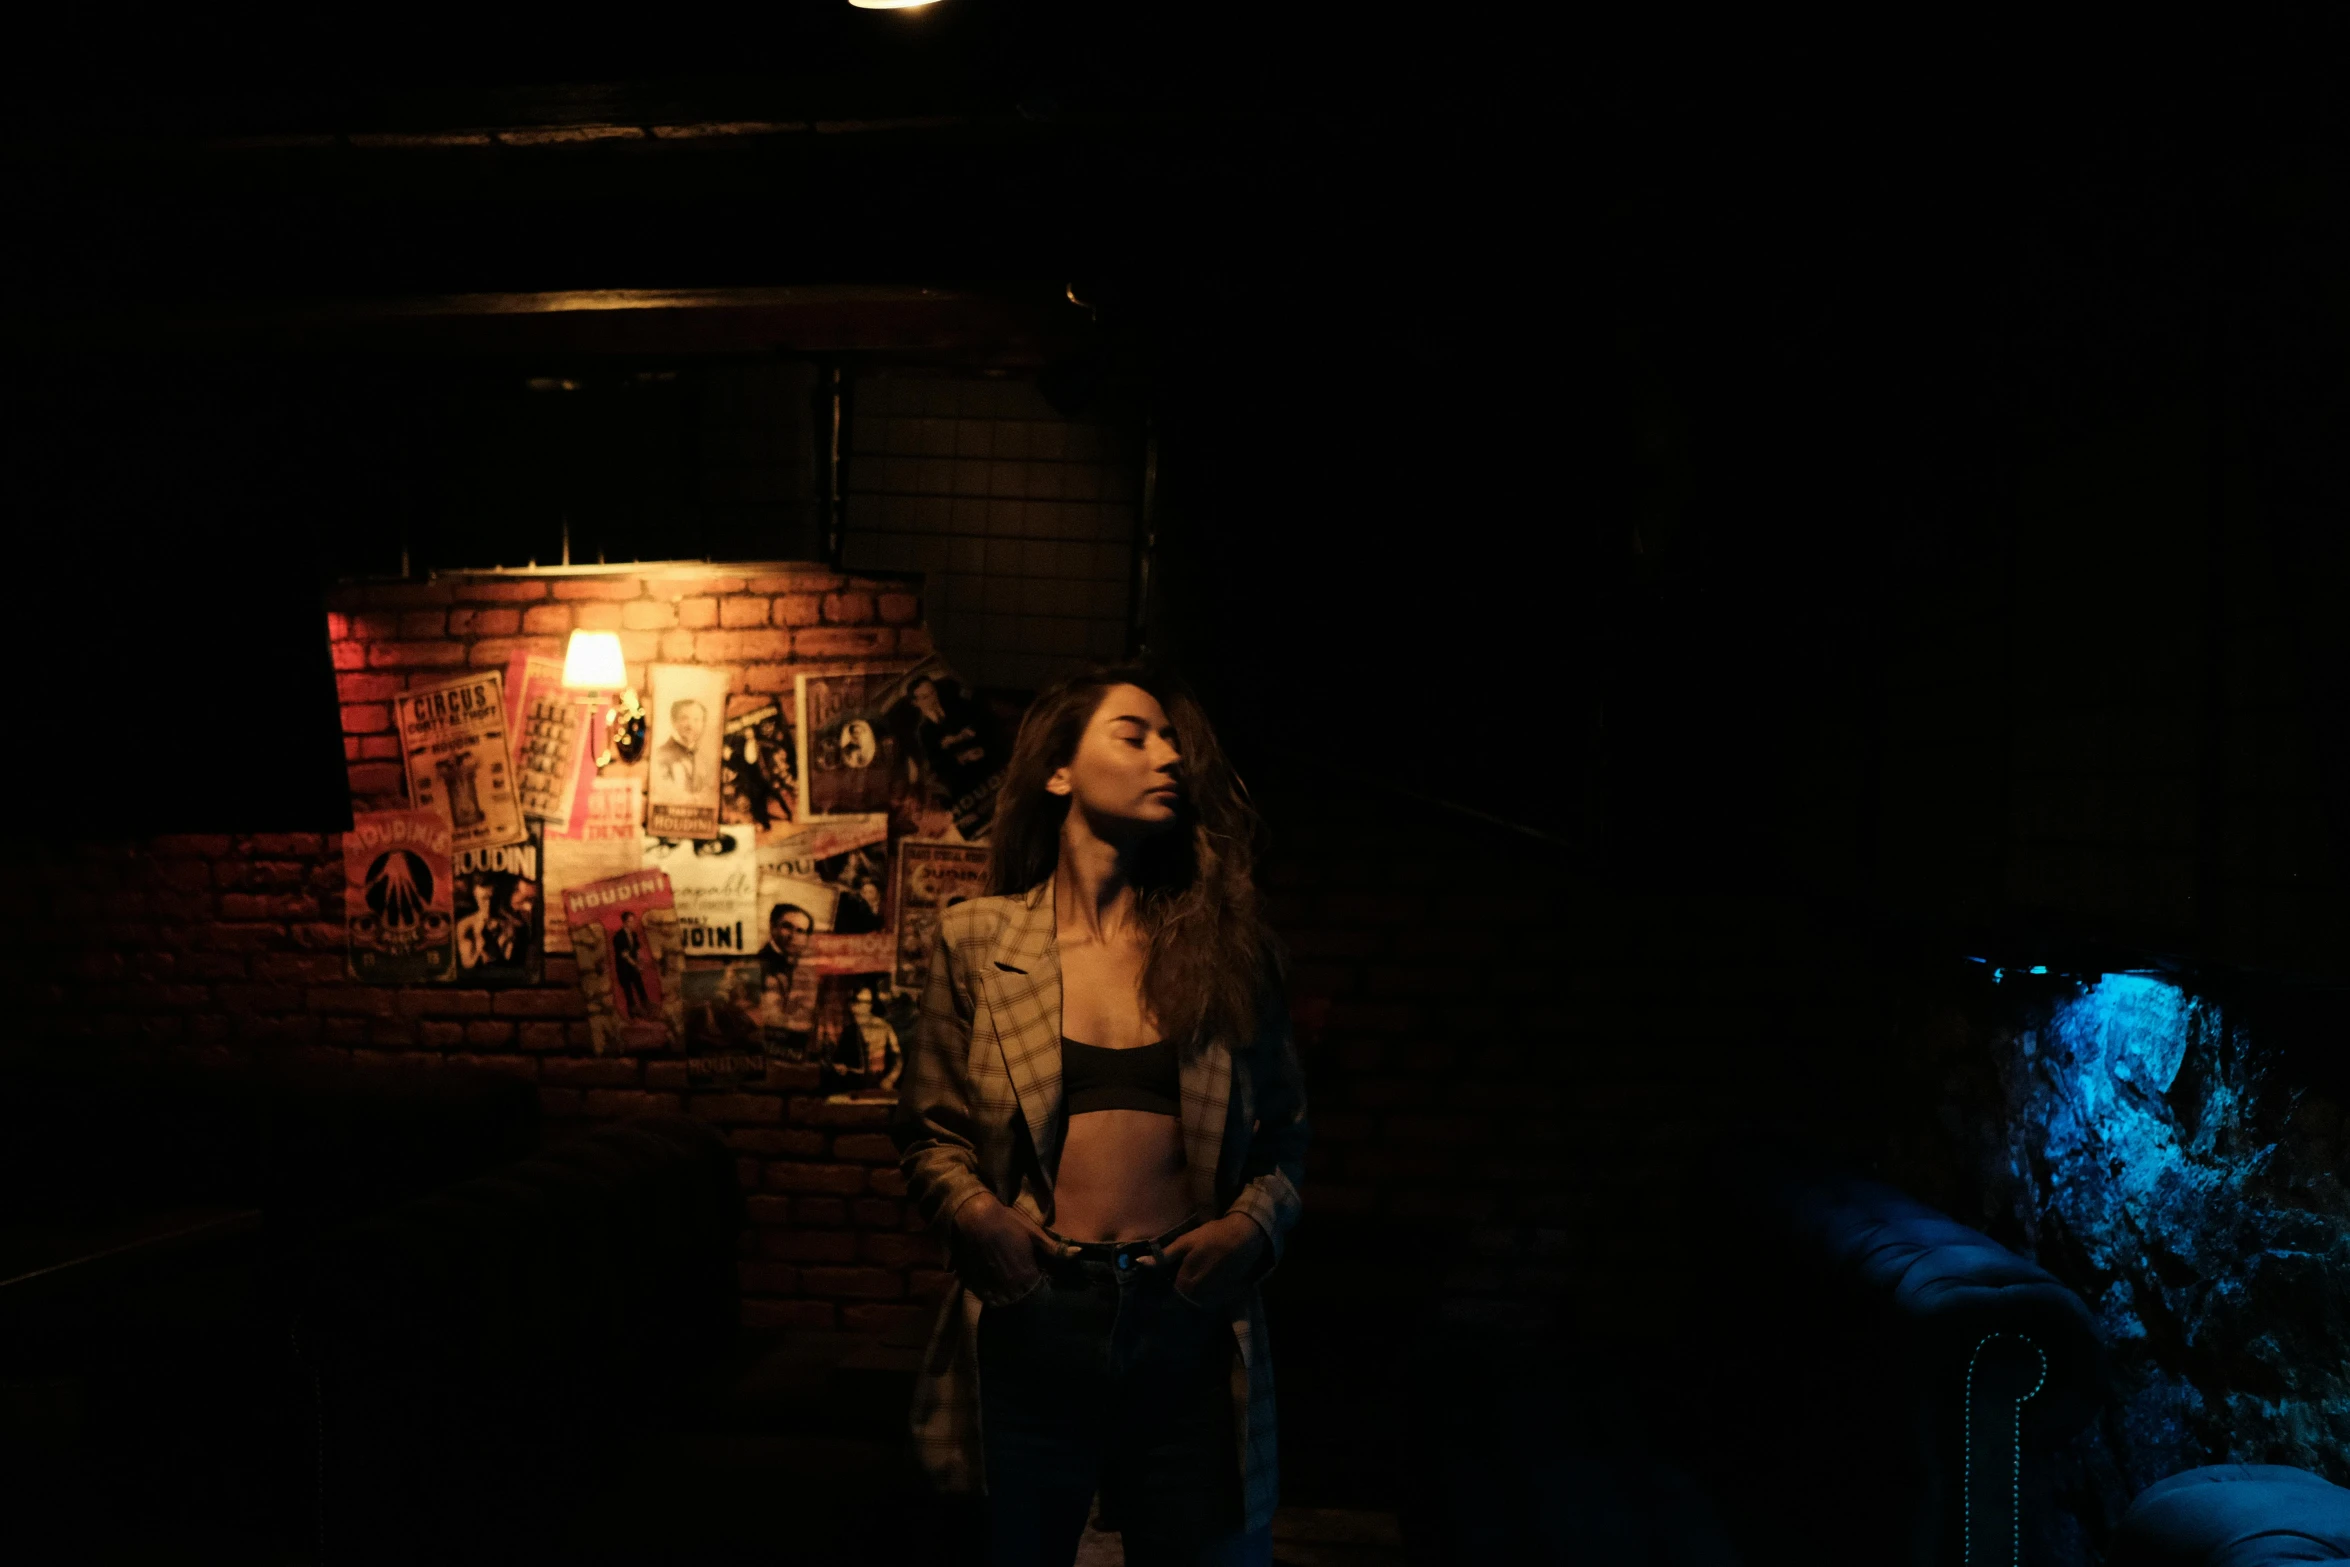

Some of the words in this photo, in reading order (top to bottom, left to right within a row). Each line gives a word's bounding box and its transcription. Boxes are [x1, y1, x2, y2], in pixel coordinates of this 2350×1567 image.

[414, 685, 486, 721] CIRCUS
[654, 816, 713, 833] HOUDINI
[569, 876, 665, 913] HOUDINI
